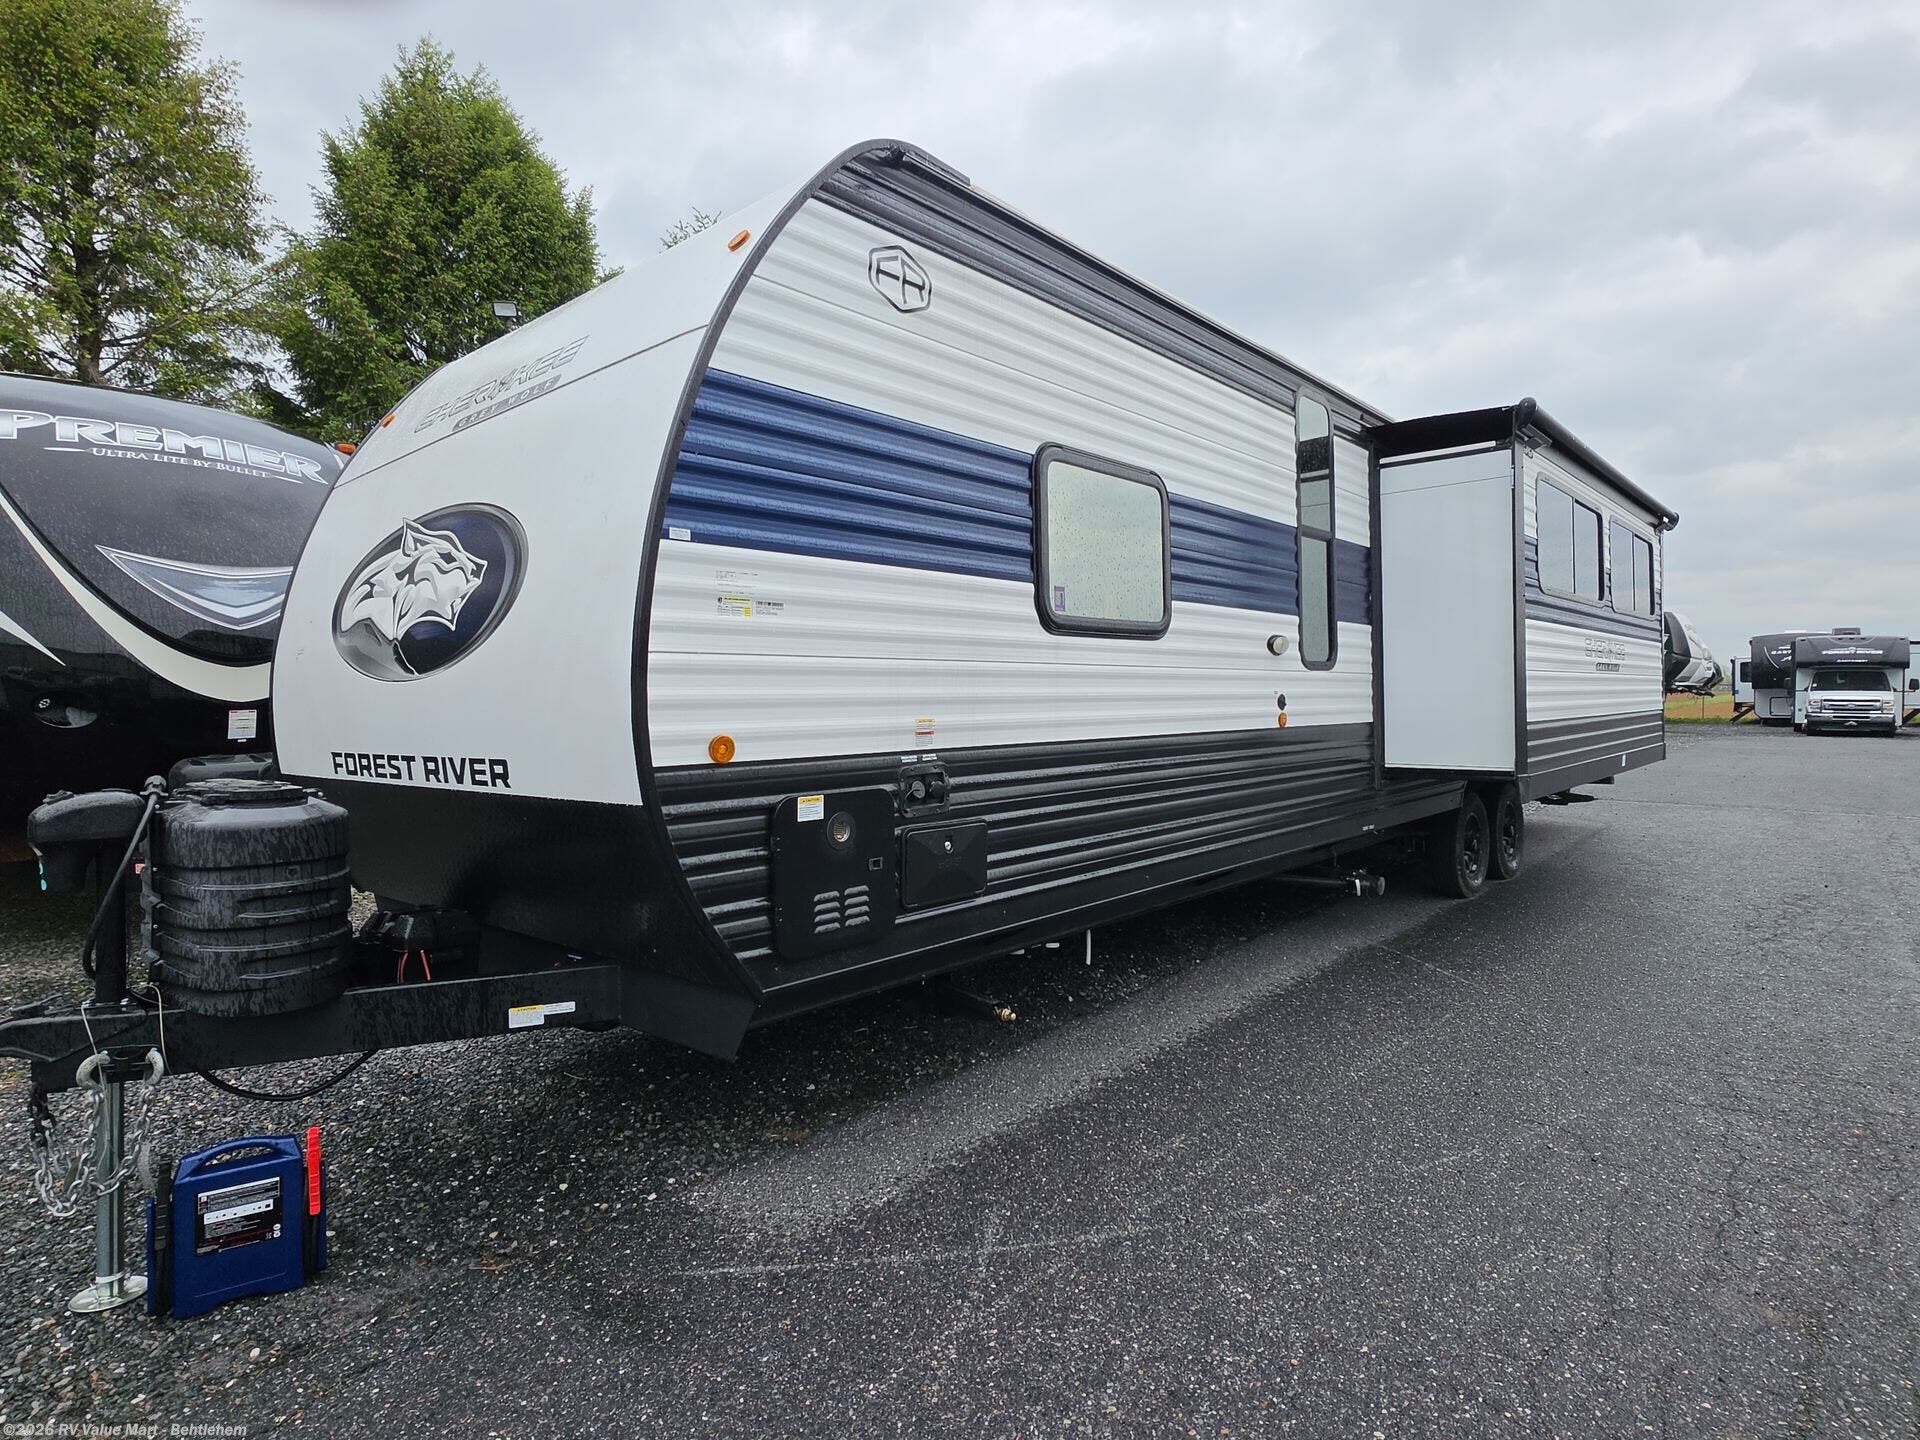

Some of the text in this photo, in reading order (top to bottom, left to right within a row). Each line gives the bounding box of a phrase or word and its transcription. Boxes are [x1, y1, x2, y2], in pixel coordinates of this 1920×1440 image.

[459, 379, 554, 427] GREY WOLF
[0, 408, 328, 485] PREMIER
[331, 751, 511, 789] FOREST RIVER
